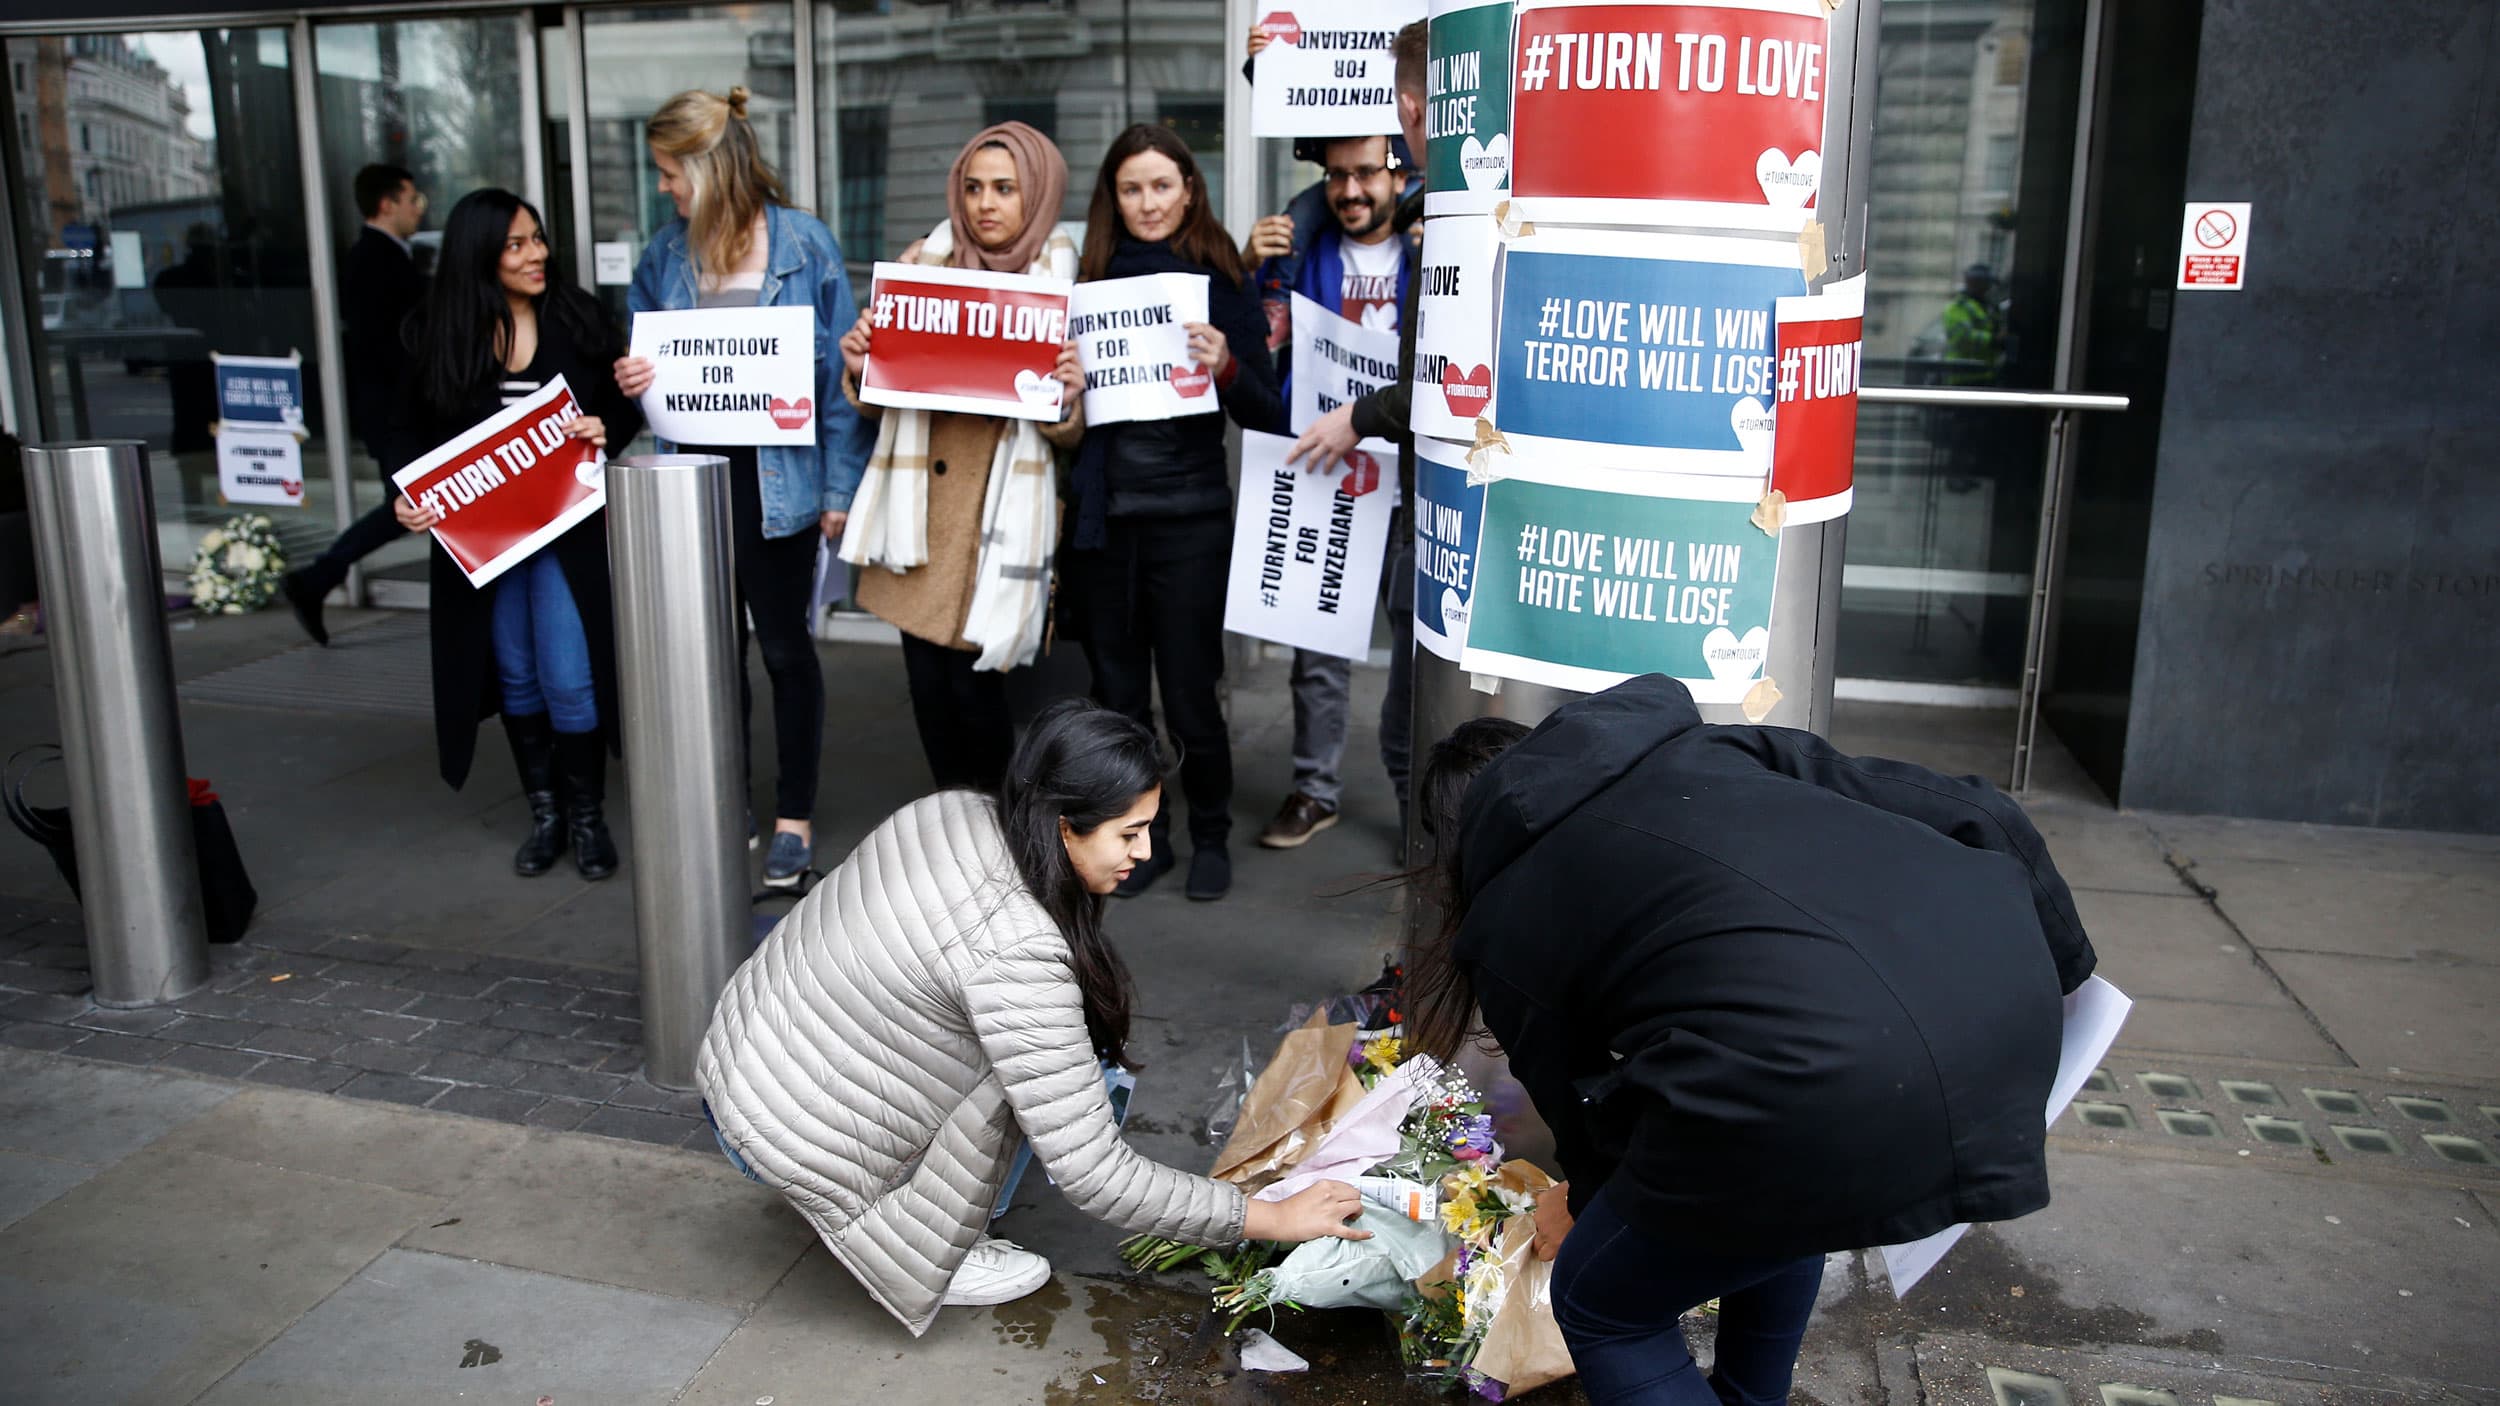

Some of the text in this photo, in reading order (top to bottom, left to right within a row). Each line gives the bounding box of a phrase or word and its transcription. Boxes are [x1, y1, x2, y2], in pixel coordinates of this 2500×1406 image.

[1334, 60, 1366, 78] FOR
[1450, 50, 1480, 93] WIN
[1521, 32, 1822, 102] #TURN TO LOVE
[1287, 87, 1393, 106] TURNTOLOVE
[1442, 95, 1477, 138] LOSE
[1464, 156, 1505, 170] #TURNTOLOVE
[1764, 171, 1814, 188] #TURNTOLOVE
[872, 292, 1065, 345] #TURN TO LOVE
[1068, 304, 1173, 341] TURNTOLOVE
[1538, 297, 1768, 350] #LOVE WILL WIN
[658, 337, 780, 357] #TURNTOLOVE
[1096, 338, 1131, 359] FOR
[1313, 337, 1400, 382] #TURNTOLO
[1523, 340, 1776, 396] TERROR WILL LOSE
[702, 365, 734, 384] FOR
[1446, 381, 1489, 399] #TURNTOLOVE
[1777, 342, 1853, 403] #TURN
[419, 454, 507, 520] #TURN
[494, 436, 537, 476] TO
[1260, 469, 1296, 608] #TURNTOLOVE
[1295, 526, 1319, 565] FOR
[1435, 503, 1463, 548] WIN
[1433, 544, 1471, 591] LOSE
[1517, 523, 1742, 584] #LOVE WILL WIN
[1518, 566, 1734, 626] HATE WILL LOSE
[1710, 648, 1761, 661] #TURNTOLOVE
